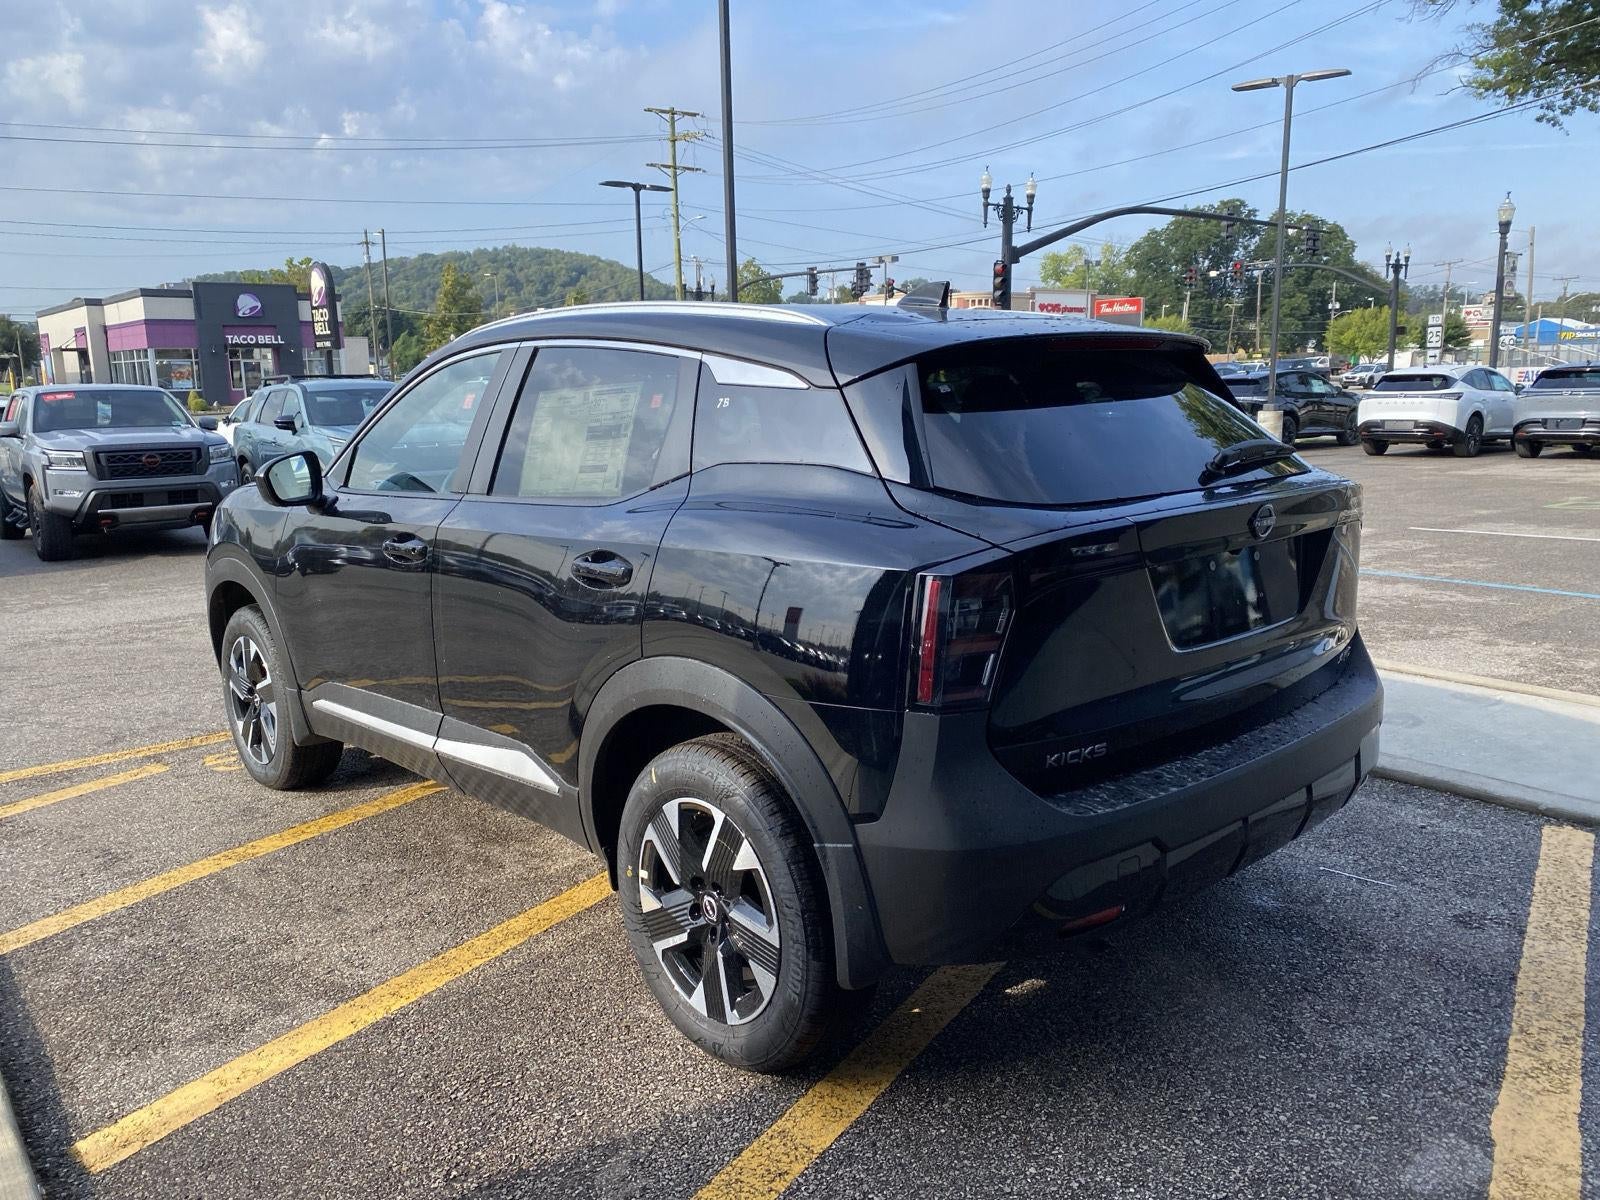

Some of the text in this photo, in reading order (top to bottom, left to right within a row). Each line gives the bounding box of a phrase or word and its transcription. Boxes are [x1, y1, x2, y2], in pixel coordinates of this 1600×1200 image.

[1046, 303, 1061, 312] CVS
[1100, 302, 1137, 313] Tim Hortons
[312, 308, 328, 321] TACO
[314, 322, 331, 335] BELL
[225, 335, 285, 344] TACO BELL
[1428, 331, 1441, 343] 25
[1045, 742, 1107, 768] KICKS
